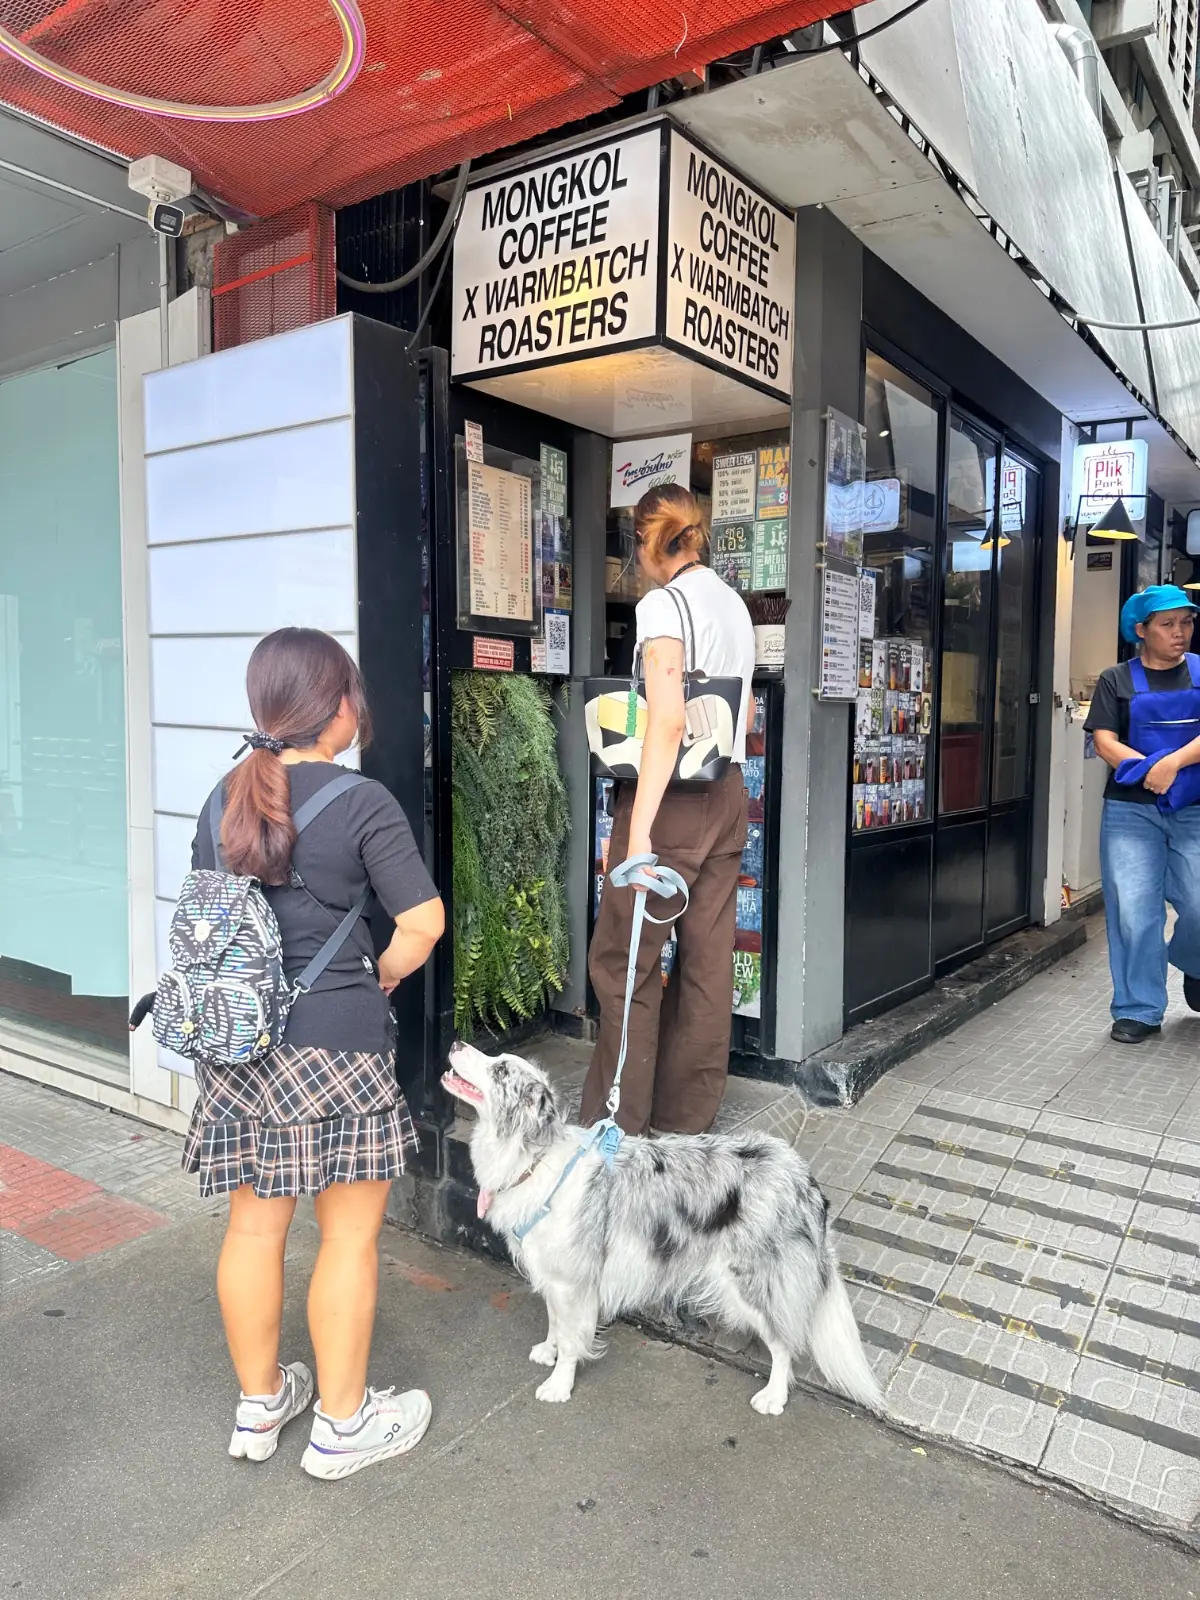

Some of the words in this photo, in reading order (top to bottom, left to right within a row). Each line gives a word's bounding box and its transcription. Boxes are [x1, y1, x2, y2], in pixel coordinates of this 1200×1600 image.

[481, 148, 628, 231] MONGKOL
[687, 152, 779, 252] MONGKOL
[498, 200, 610, 270] COFFEE
[700, 211, 770, 288] COFFEE
[462, 286, 480, 321] X
[485, 240, 650, 315] WARMBATCH
[670, 243, 686, 283] X
[689, 253, 790, 341] WARMBATCH
[478, 292, 628, 364] ROASTERS
[683, 297, 779, 380] ROASTERS
[1095, 459, 1123, 479] Plik
[756, 524, 765, 544] MADE
[755, 555, 765, 588] THAILAND
[734, 964, 755, 979] EW
